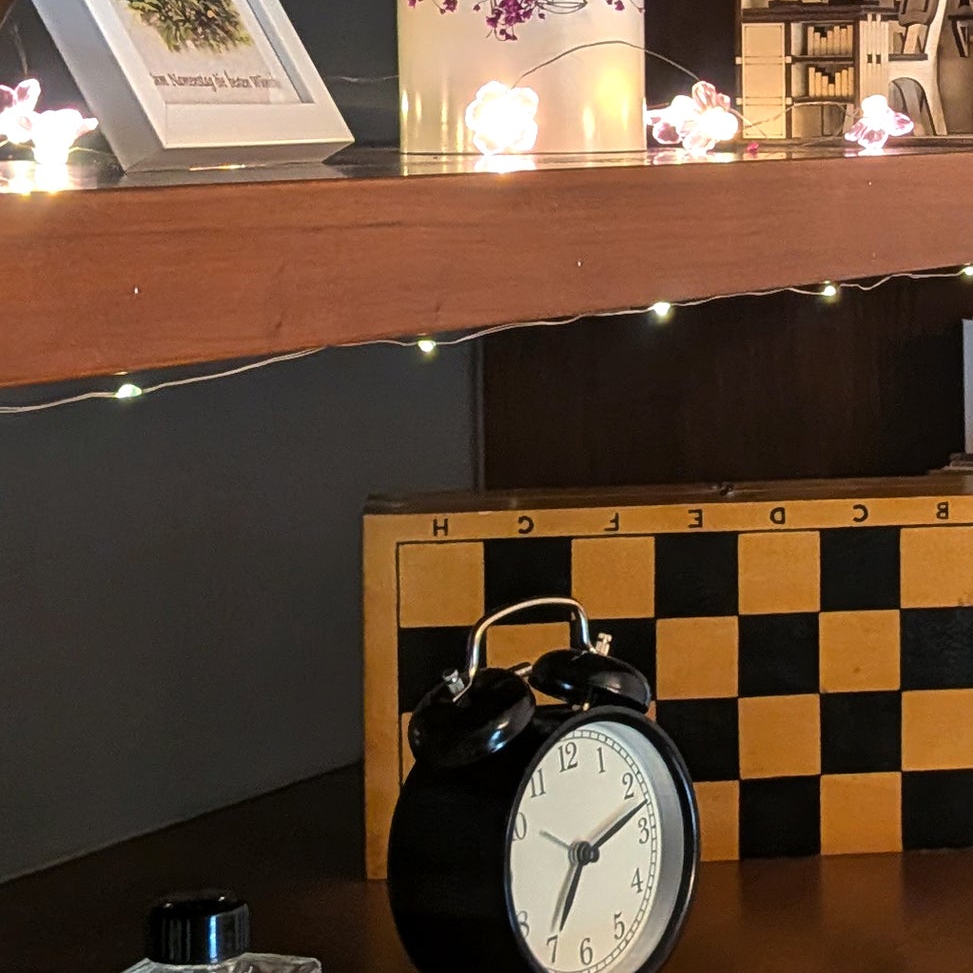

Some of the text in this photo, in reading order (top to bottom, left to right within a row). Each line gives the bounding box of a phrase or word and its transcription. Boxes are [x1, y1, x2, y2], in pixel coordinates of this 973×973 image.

[603, 512, 620, 532] F
[687, 509, 703, 529] E
[769, 507, 786, 524] D
[853, 504, 869, 523] C
[936, 501, 949, 520] B
[432, 518, 449, 537] H
[558, 741, 578, 772] 12
[597, 747, 607, 774] 1
[530, 768, 546, 799] 11
[621, 772, 635, 800] 2
[638, 817, 650, 844] 3
[630, 867, 644, 894] 4
[613, 911, 626, 941] 5
[546, 935, 558, 963] 7
[580, 937, 593, 966] 6
